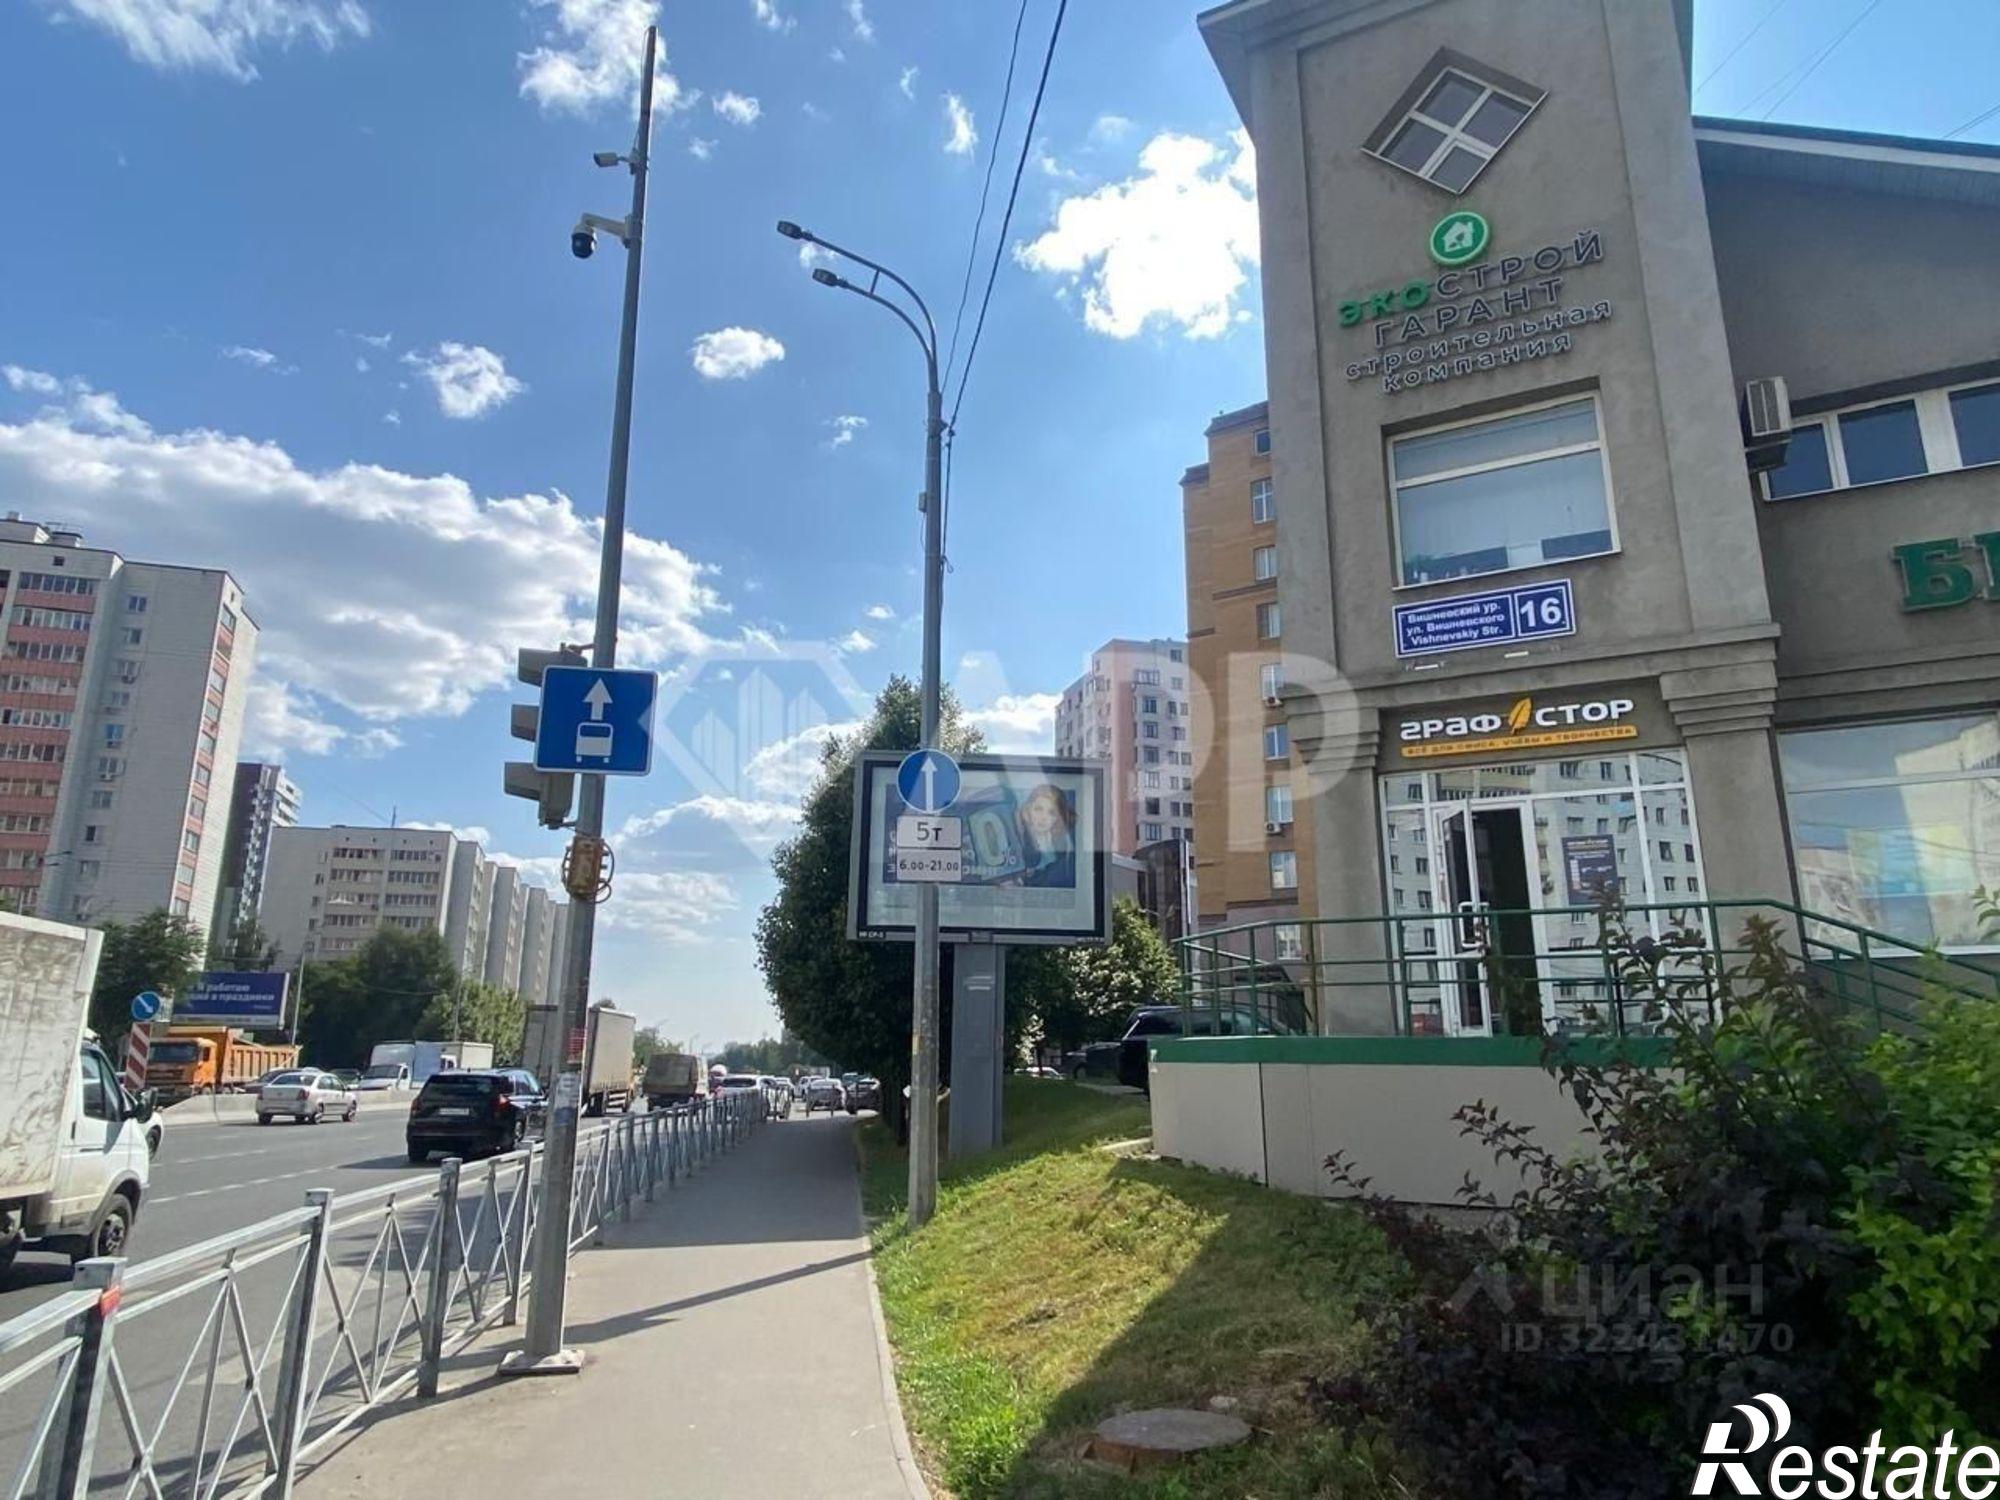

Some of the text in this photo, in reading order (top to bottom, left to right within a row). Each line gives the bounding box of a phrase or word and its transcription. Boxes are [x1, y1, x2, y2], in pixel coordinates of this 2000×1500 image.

[1374, 277, 1562, 349] ГАРАНТ
[1346, 299, 1613, 380] строительная
[1383, 333, 1572, 396] компания
[1406, 614, 1505, 637] ул. Вишневского
[1520, 597, 1562, 627] 16
[1411, 626, 1503, 646] Vishnevskiy Str.
[1535, 699, 1634, 727] СТОР
[916, 821, 943, 841] 5т
[900, 857, 960, 872] 6.00-21.00
